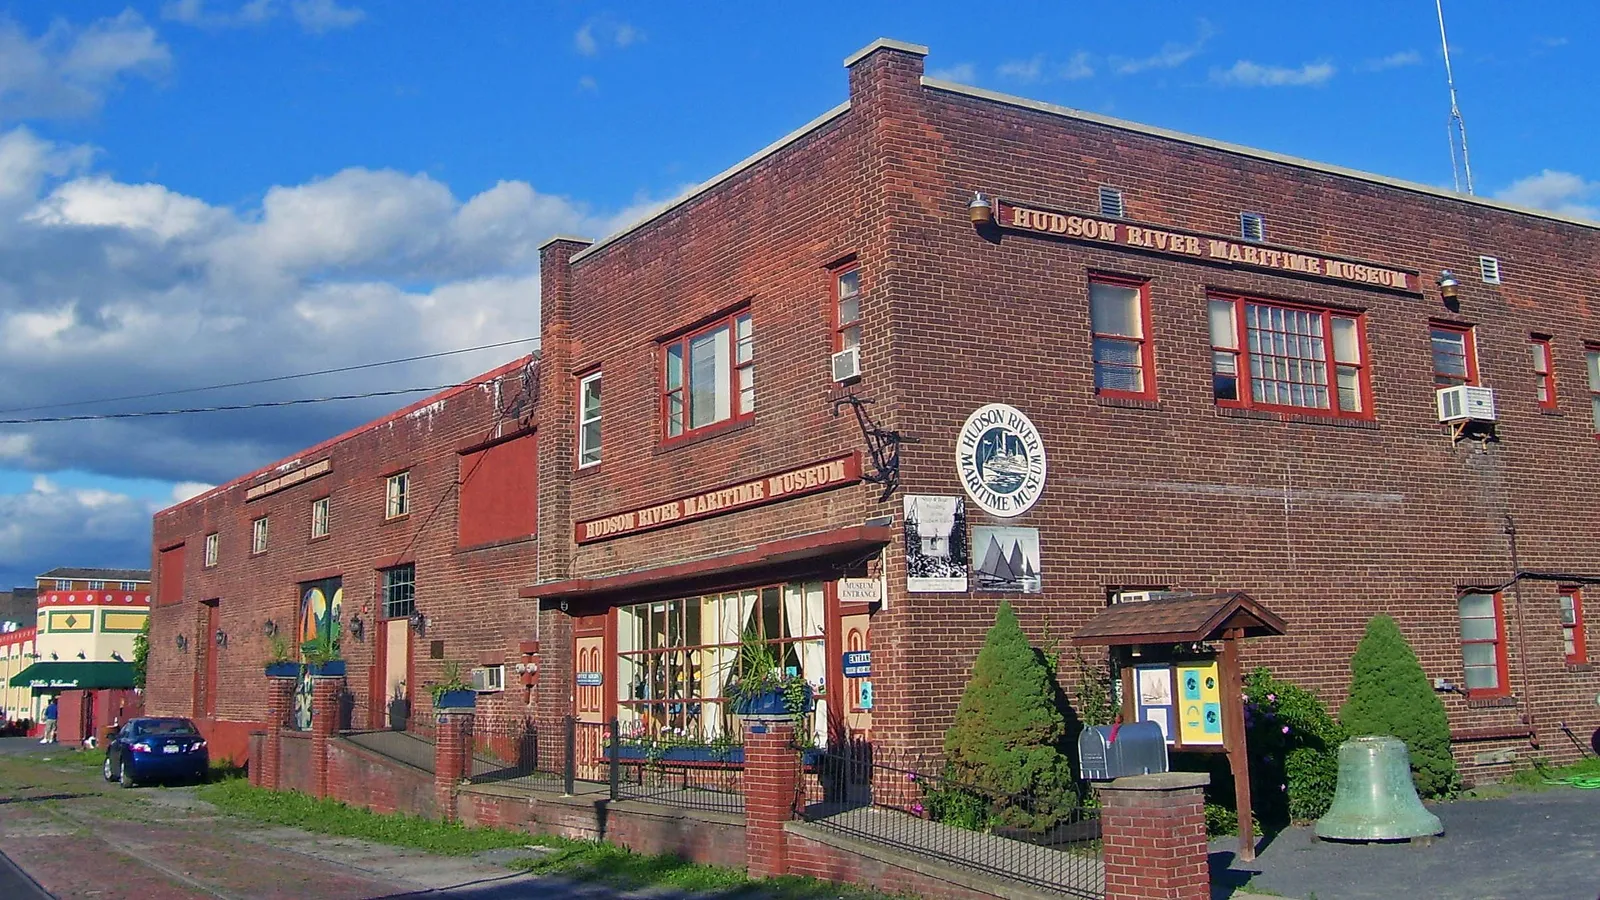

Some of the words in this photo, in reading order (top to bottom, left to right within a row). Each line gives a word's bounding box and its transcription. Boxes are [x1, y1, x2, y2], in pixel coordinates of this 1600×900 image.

[1012, 206, 1118, 242] HUDSON
[1126, 225, 1202, 256] RIVER
[1208, 239, 1321, 275] MARITIME
[1325, 259, 1408, 289] MUSEUM
[962, 409, 1006, 449] HUDSON
[1007, 412, 1039, 453] RIVER
[585, 512, 635, 540] HUDSON
[638, 502, 680, 528] RIVER
[684, 481, 764, 517] MARITIME
[769, 460, 846, 498] MUSEUM
[960, 452, 1010, 511] MARITIME
[1012, 454, 1042, 510] MUSEUM
[842, 590, 877, 598] ENTRANCE
[845, 582, 875, 590] MUSEUM
